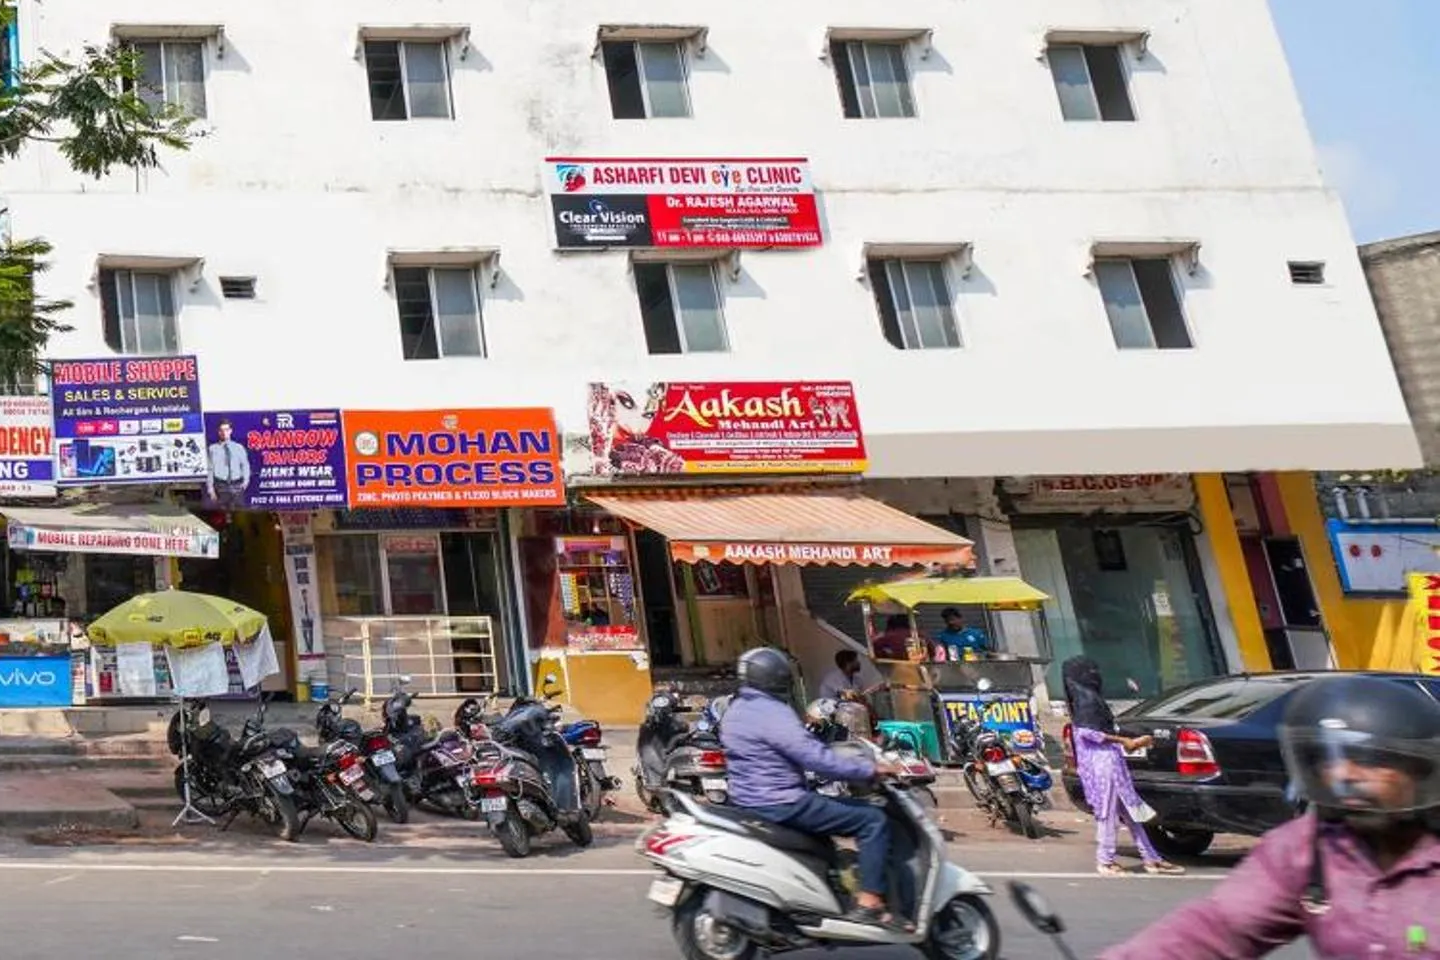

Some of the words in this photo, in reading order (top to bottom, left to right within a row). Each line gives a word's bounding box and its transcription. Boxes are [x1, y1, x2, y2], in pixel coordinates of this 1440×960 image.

[593, 167, 664, 184] ASHARFI
[669, 167, 706, 184] DEVI
[711, 165, 742, 187] eye
[747, 167, 802, 185] CLINIC
[666, 196, 683, 208] Dr.
[686, 196, 734, 208] RAJESH
[738, 196, 797, 208] AGARWAL
[560, 211, 597, 224] Clear
[600, 210, 645, 224] Vision
[55, 362, 123, 385] MOBILE
[126, 358, 196, 383] SHOPPE
[64, 389, 111, 403] SALES
[114, 389, 126, 401] &
[128, 385, 189, 400] SERVICE
[664, 387, 806, 429] Aakash
[718, 419, 785, 430] Mehandi
[788, 420, 816, 430] Art
[247, 428, 339, 450] RAINBOW
[385, 430, 552, 457] MOHAN
[262, 449, 328, 465] TAILORS
[298, 465, 334, 478] WEAR
[354, 460, 555, 487] PROCESS
[382, 492, 412, 502] PHOTO
[455, 491, 462, 500] &
[38, 532, 76, 545] MOBILE
[78, 533, 131, 548] REPAIRING
[134, 535, 162, 550] DONE
[164, 538, 189, 551] HERE
[724, 544, 786, 560] AAKASH
[788, 544, 857, 560] MEHANDI
[862, 546, 893, 560] ART
[946, 701, 979, 722] TEA
[983, 701, 1030, 723] POINT
